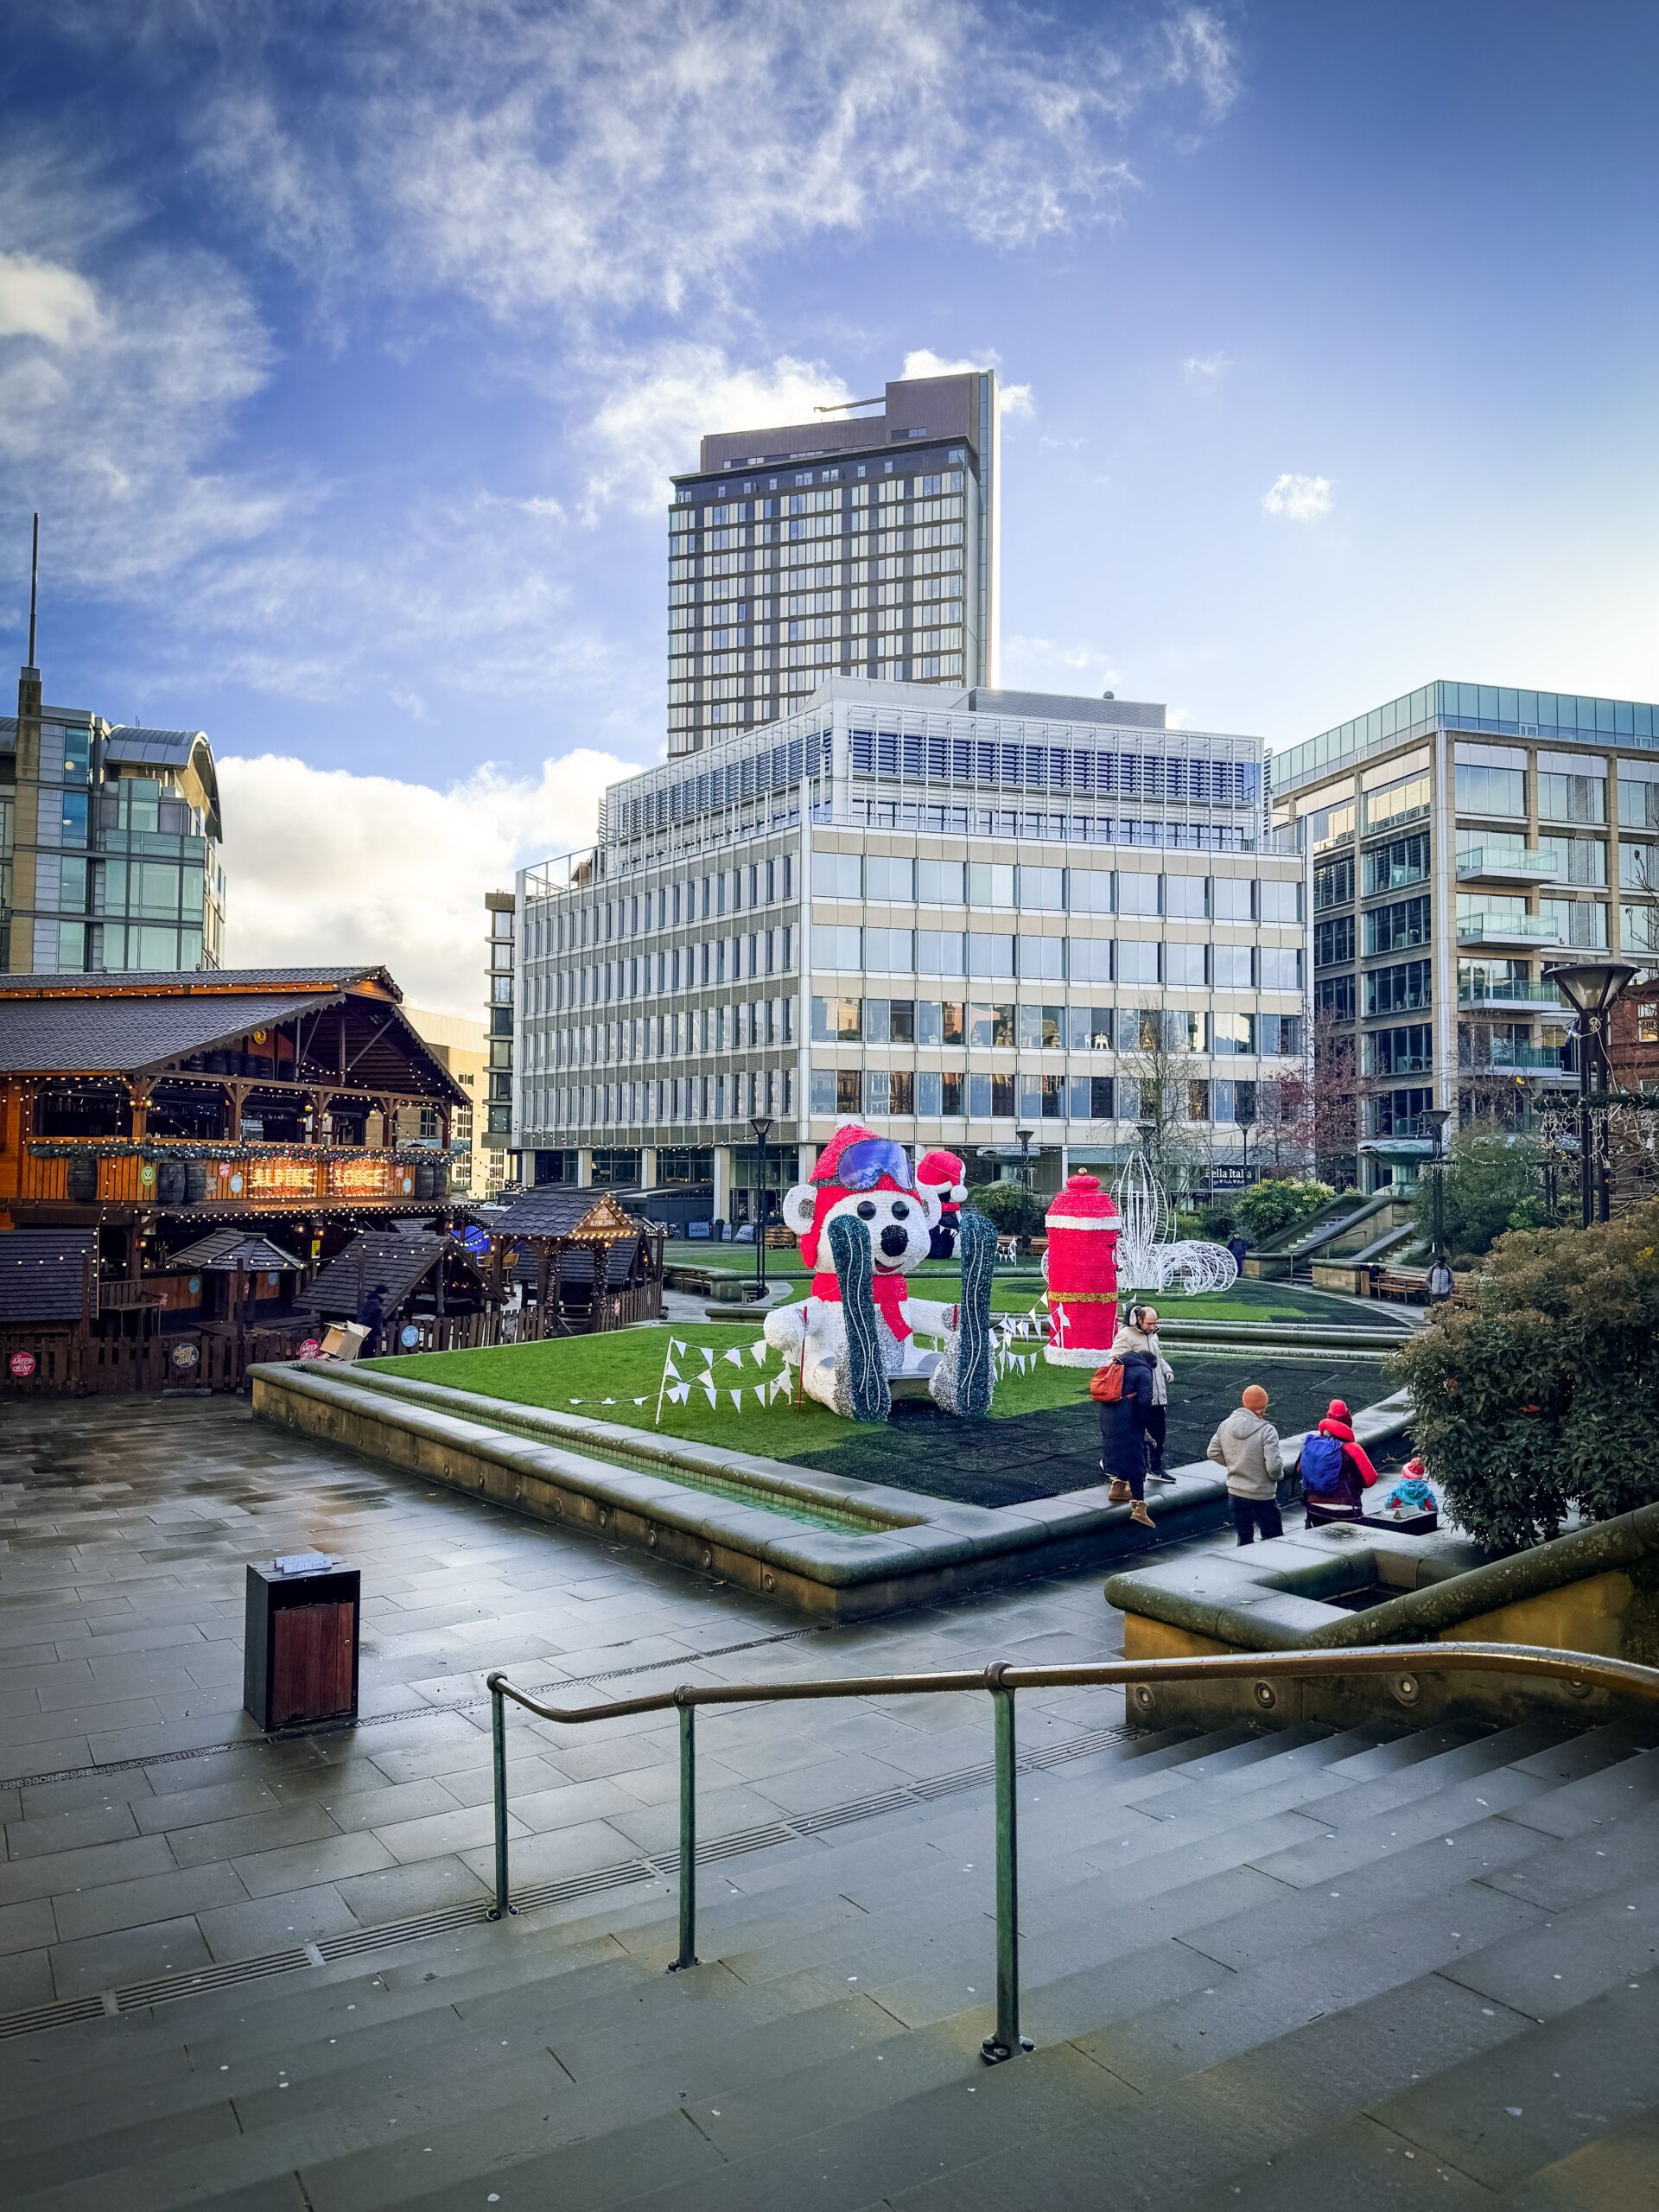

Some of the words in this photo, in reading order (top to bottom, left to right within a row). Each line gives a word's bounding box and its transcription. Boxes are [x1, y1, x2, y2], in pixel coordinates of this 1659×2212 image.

[252, 1167, 312, 1187] ALPINE
[334, 1168, 382, 1187] LODGE
[1229, 1168, 1252, 1179] Itala
[12, 1355, 34, 1364] SPICED
[13, 1365, 32, 1375] WINE
